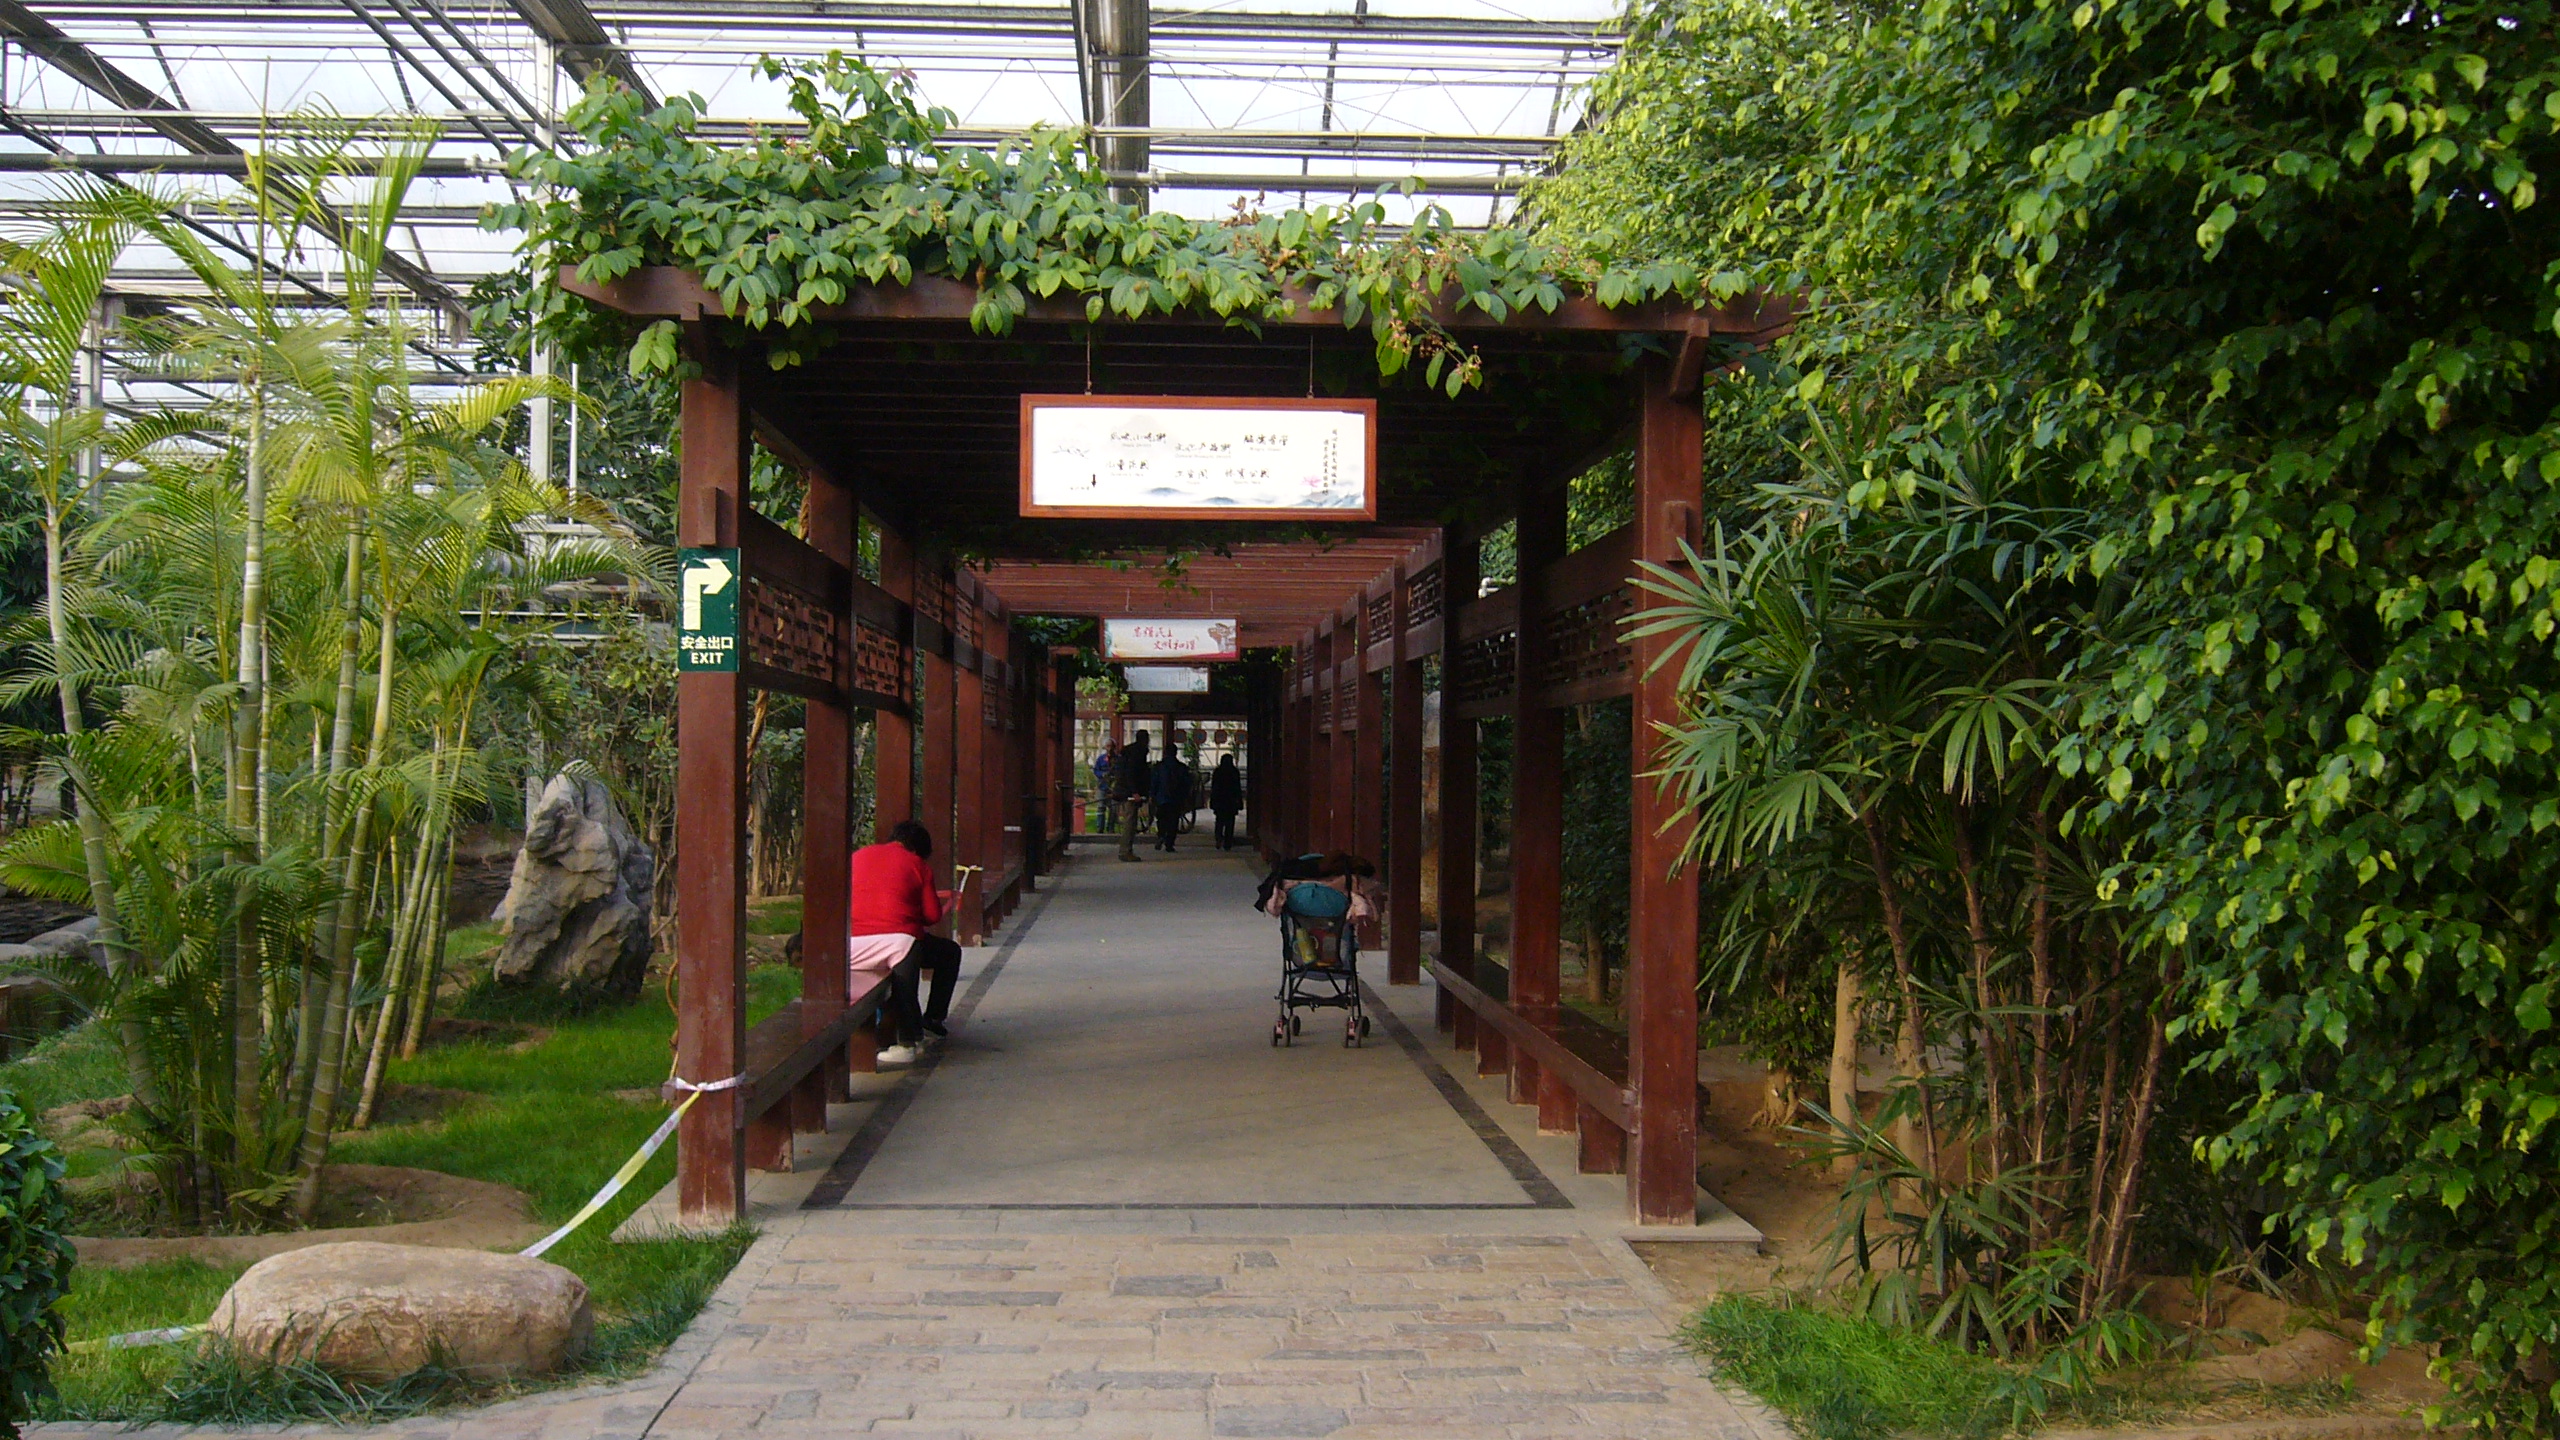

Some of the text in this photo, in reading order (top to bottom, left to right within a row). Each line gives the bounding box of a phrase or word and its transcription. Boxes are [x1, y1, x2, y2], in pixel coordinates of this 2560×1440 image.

[681, 635, 734, 650] 安全出口
[691, 651, 724, 664] EXIT
